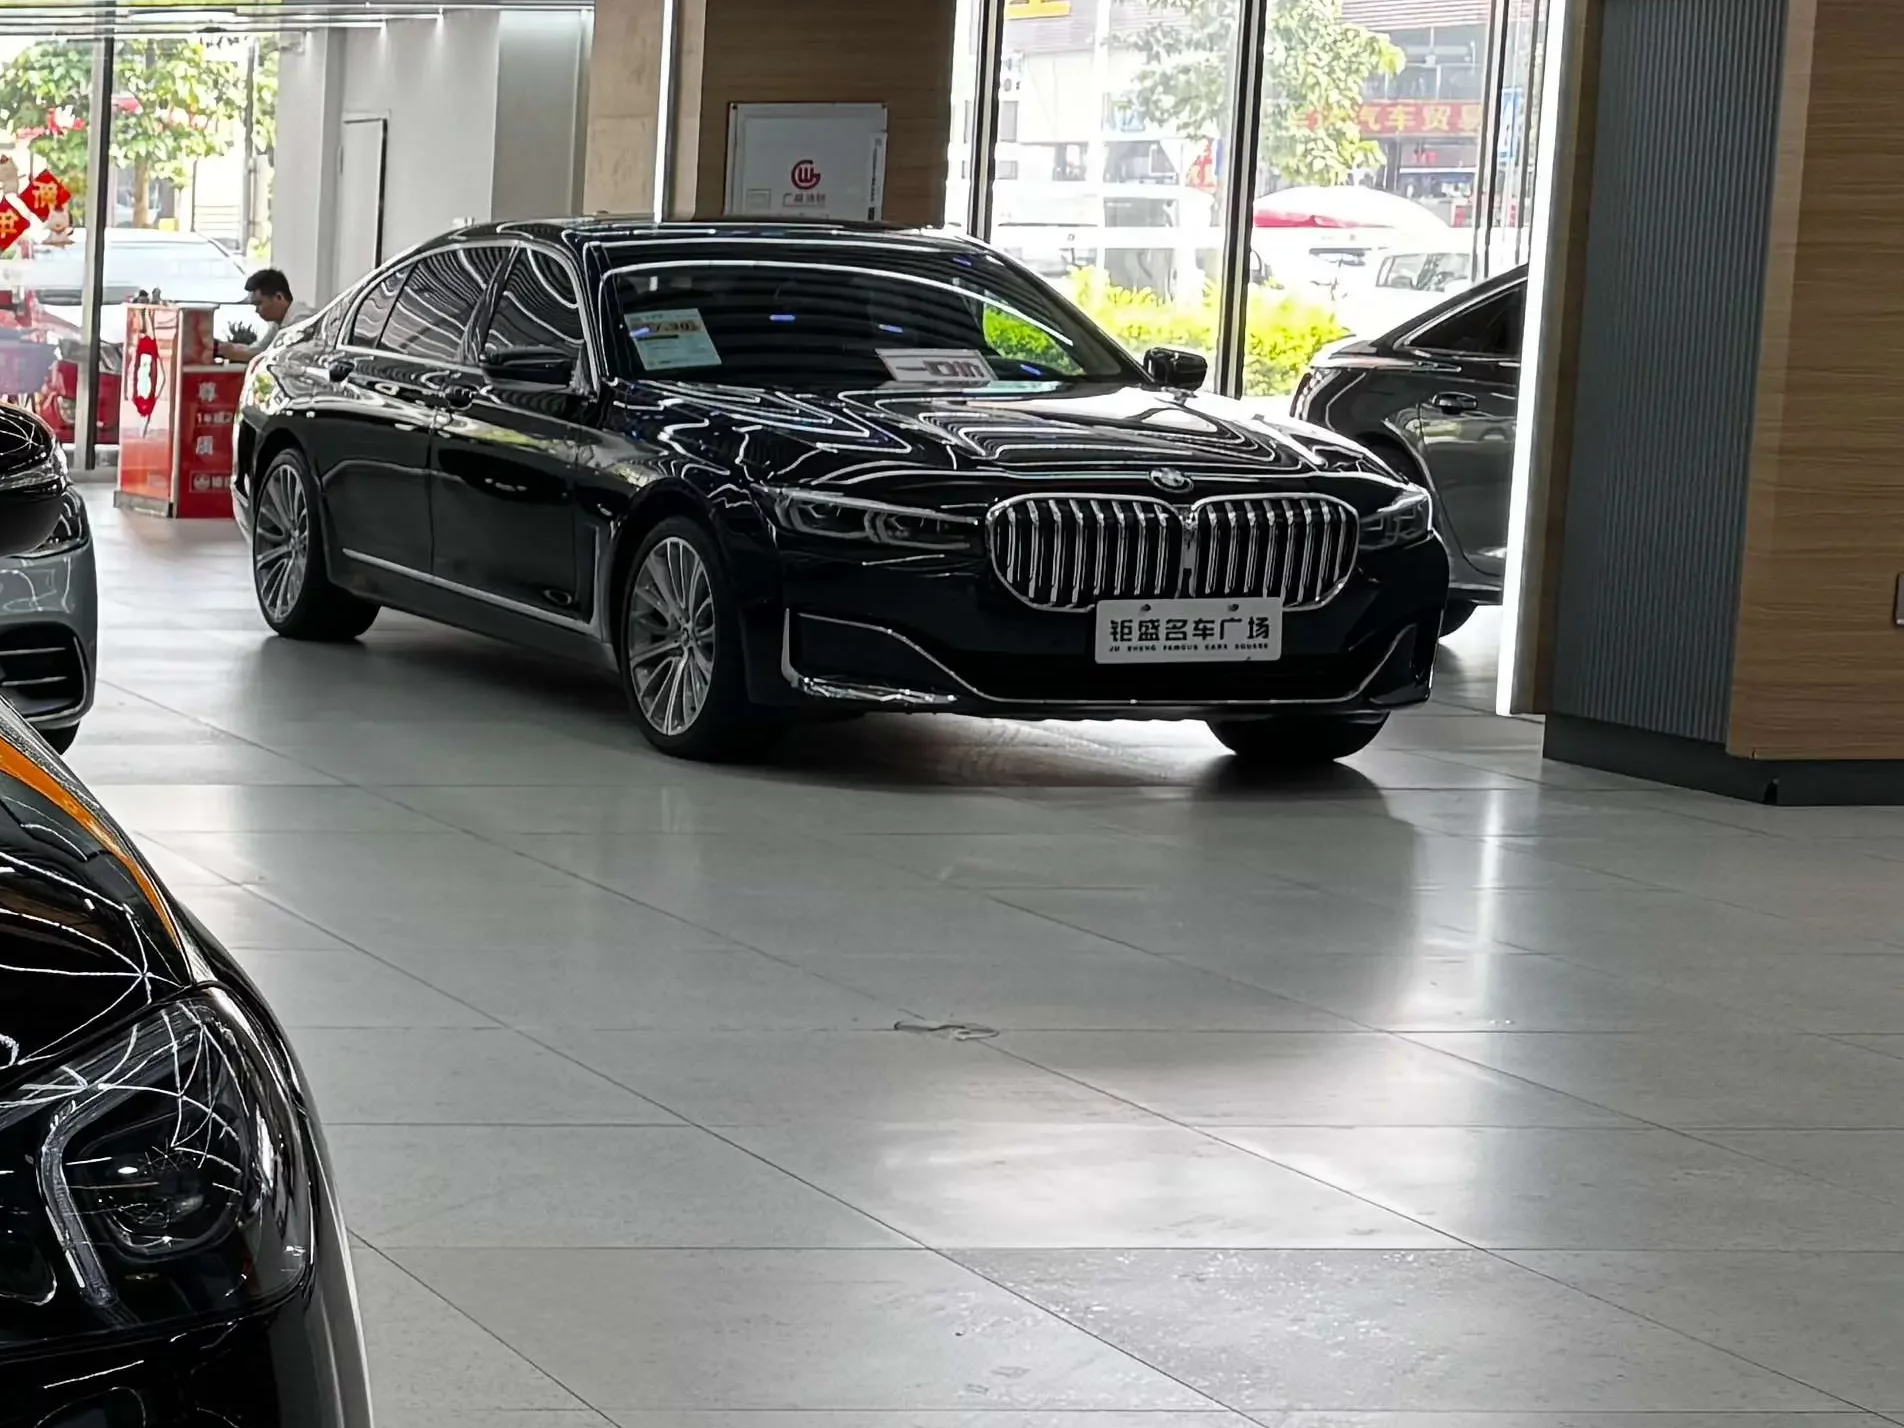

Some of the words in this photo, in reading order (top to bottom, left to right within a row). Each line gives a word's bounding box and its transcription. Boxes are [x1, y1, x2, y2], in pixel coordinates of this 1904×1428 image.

[1110, 617, 1269, 642] 钜盛名车广场
